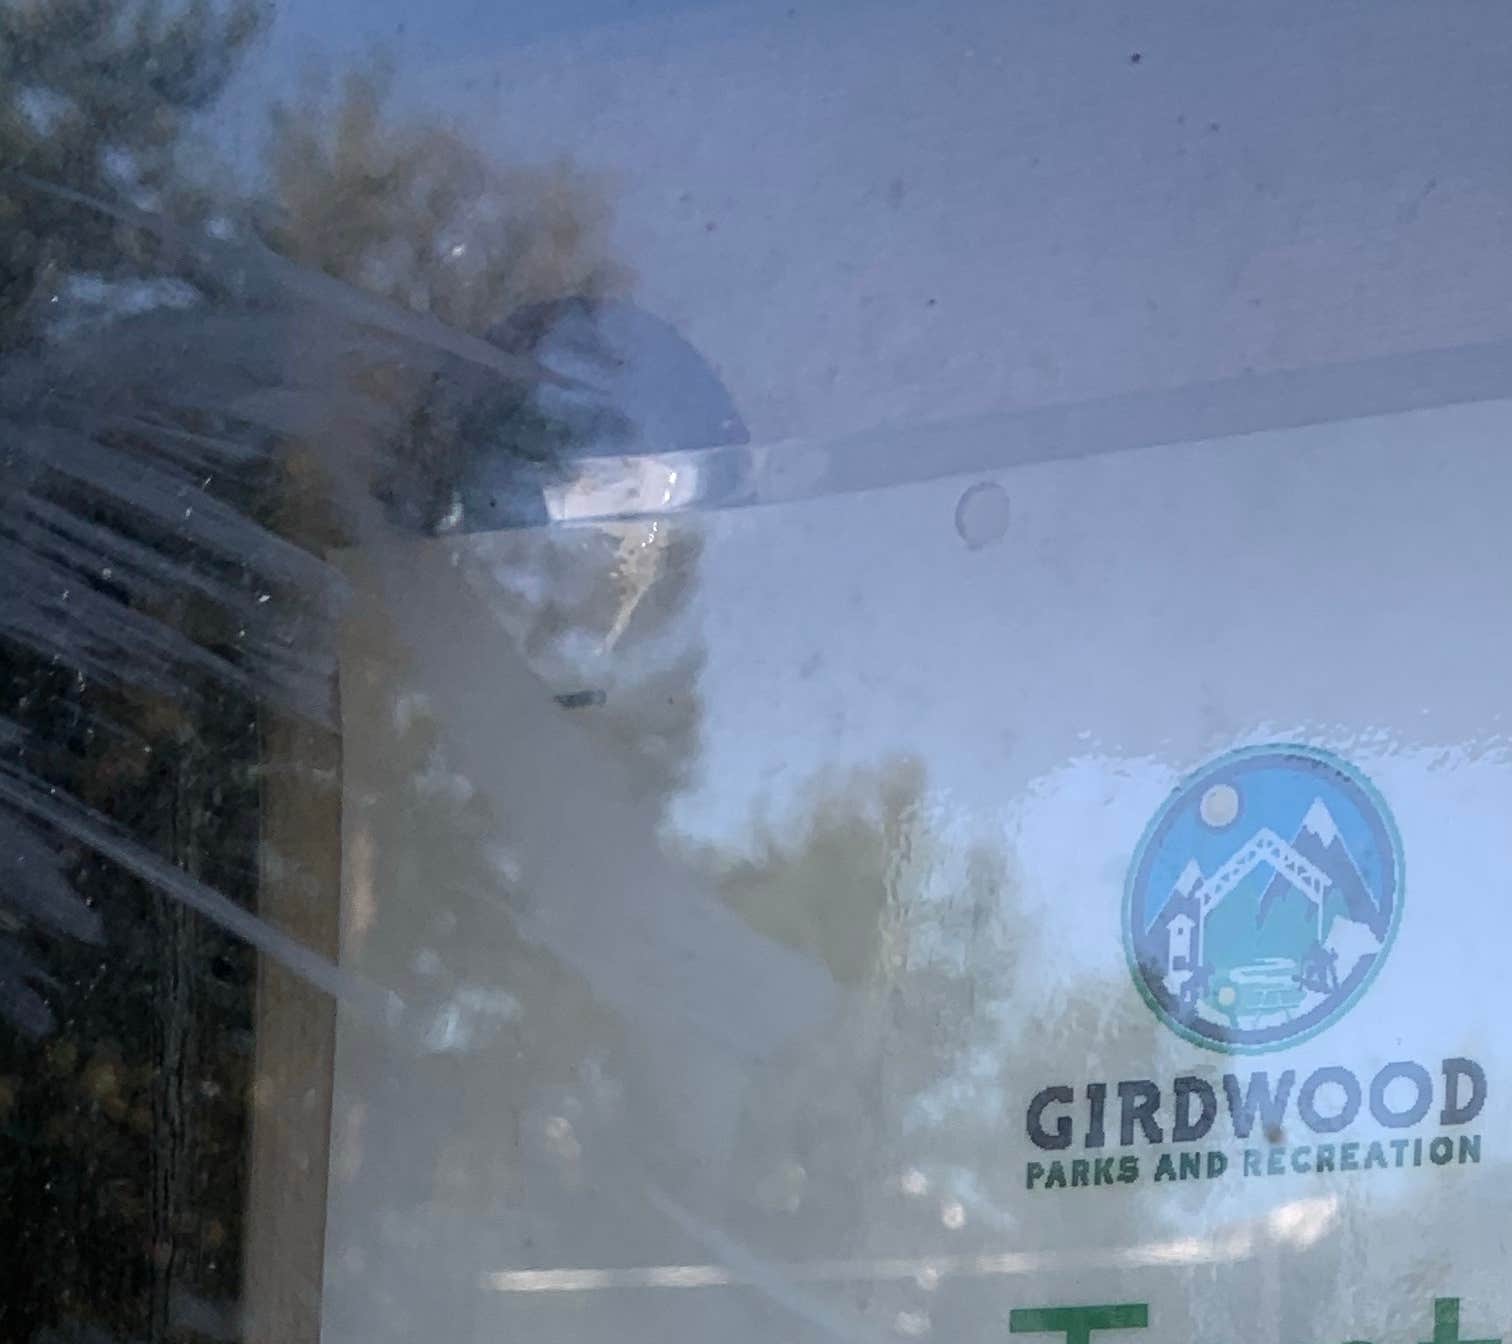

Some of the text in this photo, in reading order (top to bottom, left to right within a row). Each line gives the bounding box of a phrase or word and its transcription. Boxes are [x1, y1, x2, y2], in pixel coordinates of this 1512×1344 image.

[1025, 1057, 1488, 1150] GIRDWOOD
[1025, 1134, 1482, 1190] PARKS AND RECREATION
